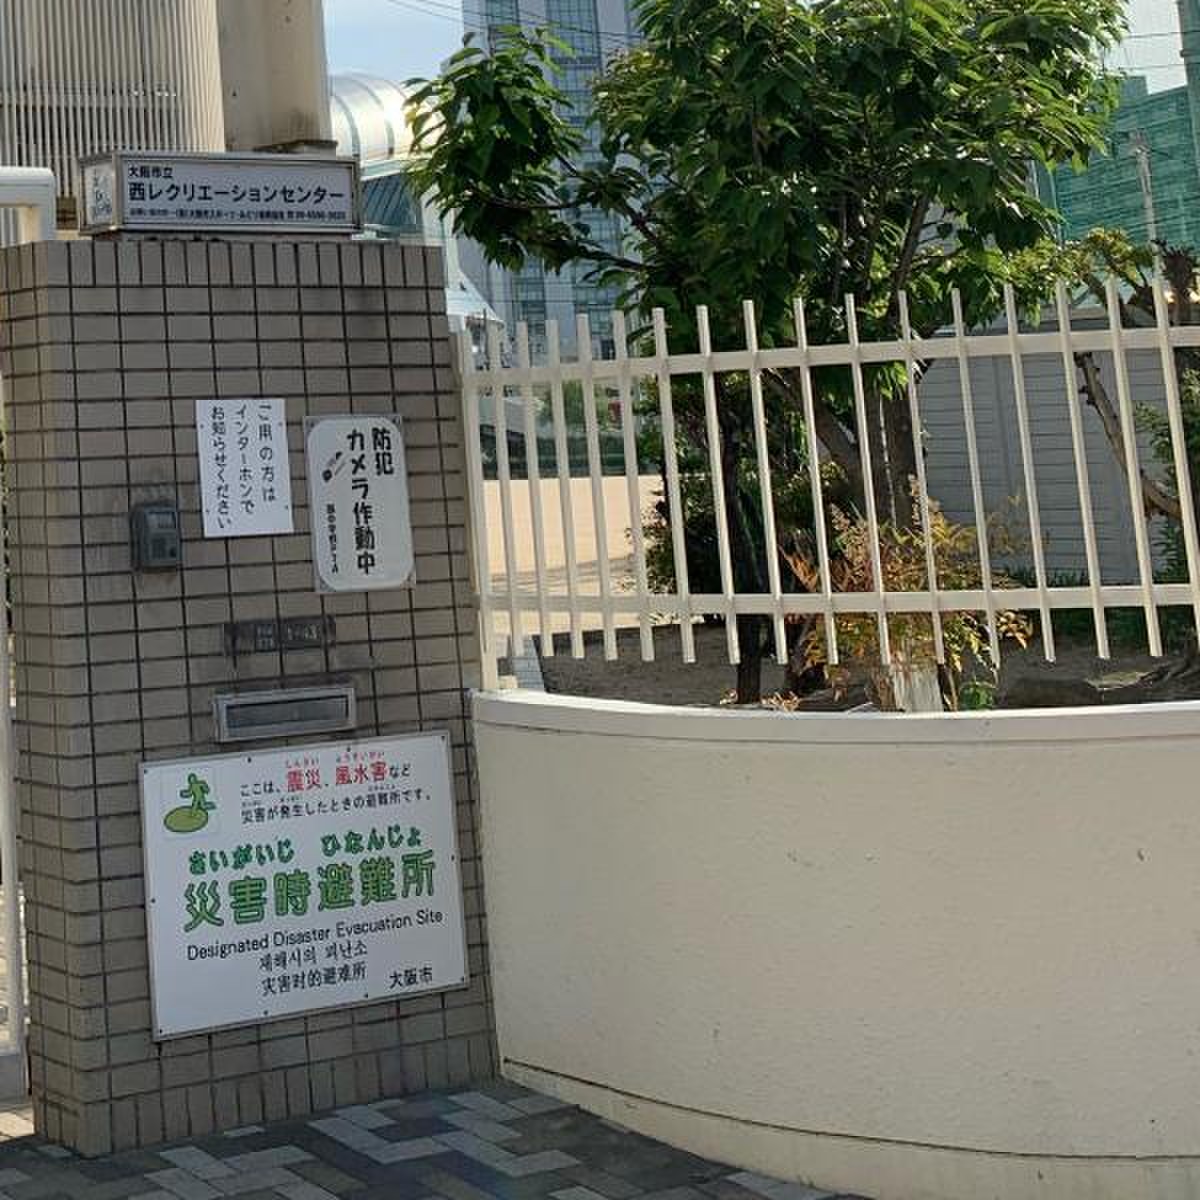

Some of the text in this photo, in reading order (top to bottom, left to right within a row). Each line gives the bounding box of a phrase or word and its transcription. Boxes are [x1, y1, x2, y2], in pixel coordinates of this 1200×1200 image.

[128, 182, 345, 205] 西レクリエーションセンター
[210, 405, 232, 529] お知らせください
[235, 404, 255, 515] インターホンで
[371, 427, 395, 477] 防犯
[347, 429, 376, 575] カメラ作動中
[188, 824, 422, 876] さいがいじ ひなんじょ
[183, 850, 435, 933] 災害時避難所
[187, 909, 443, 960] Designated Disaster Evacuation Site
[389, 966, 434, 990] 大阪市
